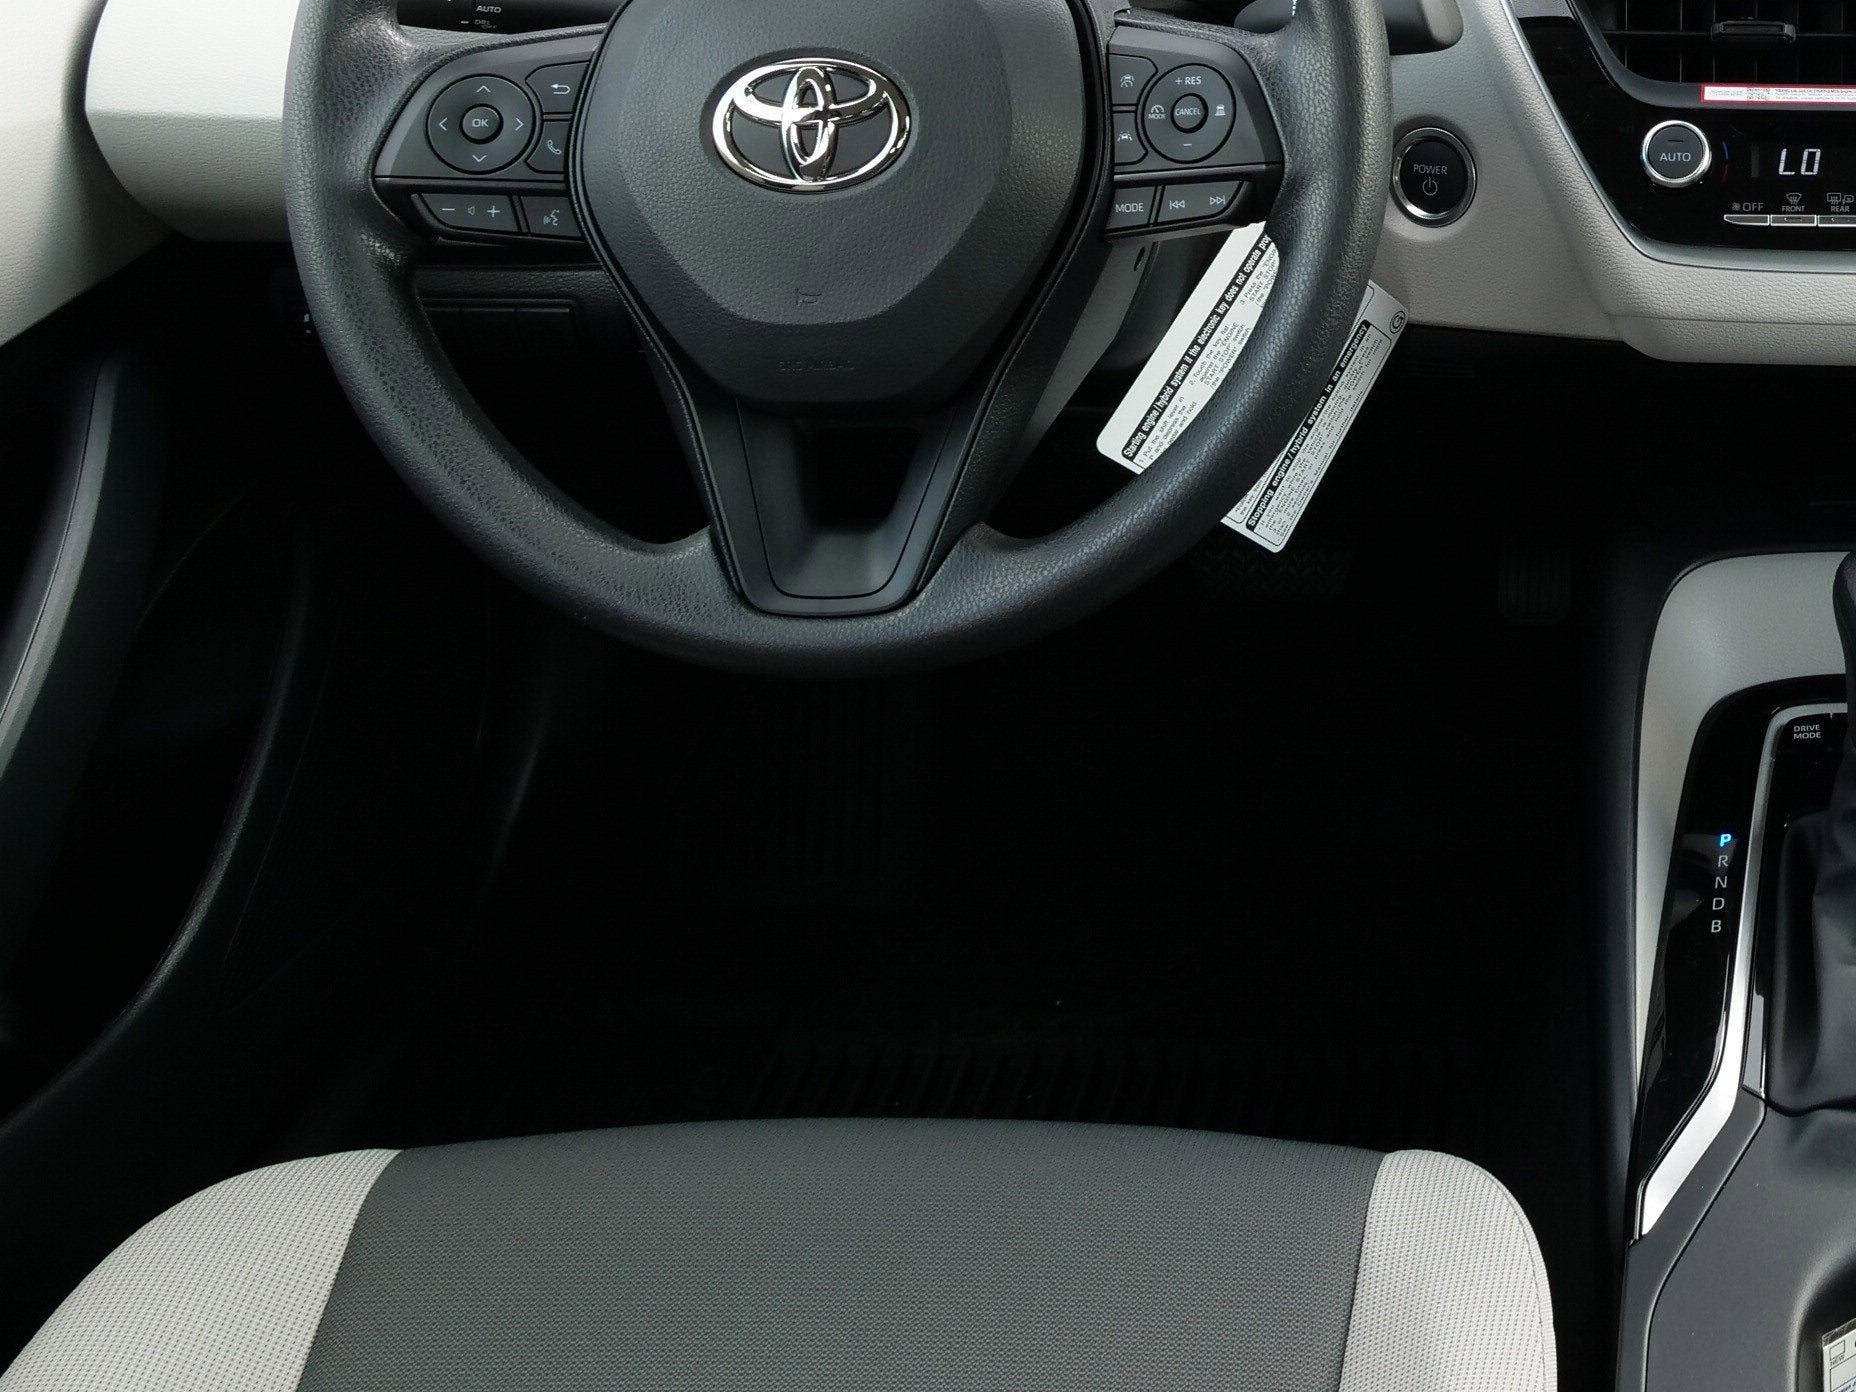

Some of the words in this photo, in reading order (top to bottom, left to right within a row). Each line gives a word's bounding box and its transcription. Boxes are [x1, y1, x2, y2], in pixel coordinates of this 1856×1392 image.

[476, 5, 501, 13] AUTO
[1184, 76, 1202, 85] RES
[1174, 107, 1201, 116] CANCEL
[472, 118, 489, 128] OK
[1659, 152, 1691, 162] AUTO
[1778, 148, 1821, 176] LO
[1413, 164, 1448, 175] POWER
[1115, 202, 1144, 212] MODE
[1742, 202, 1764, 211] OFF
[1241, 247, 1263, 274] operate
[1233, 271, 1246, 285] not
[1223, 283, 1238, 301] does
[1214, 300, 1229, 315] key
[1195, 312, 1220, 345] electronic
[1187, 343, 1200, 357] the
[1182, 355, 1193, 364] if
[1169, 362, 1190, 387] system
[1247, 487, 1274, 526] Stopping
[1305, 394, 1328, 425] system
[1323, 382, 1334, 393] in
[1330, 369, 1341, 381] an
[1338, 323, 1368, 368] emergency
[1123, 430, 1146, 458] Starting
[1793, 724, 1820, 732] DRIVE
[1793, 731, 1821, 739] MODE
[1719, 833, 1732, 847] P
[1717, 854, 1729, 867] R
[1715, 876, 1728, 889] N
[1712, 897, 1725, 910] D
[1711, 920, 1722, 933] B
